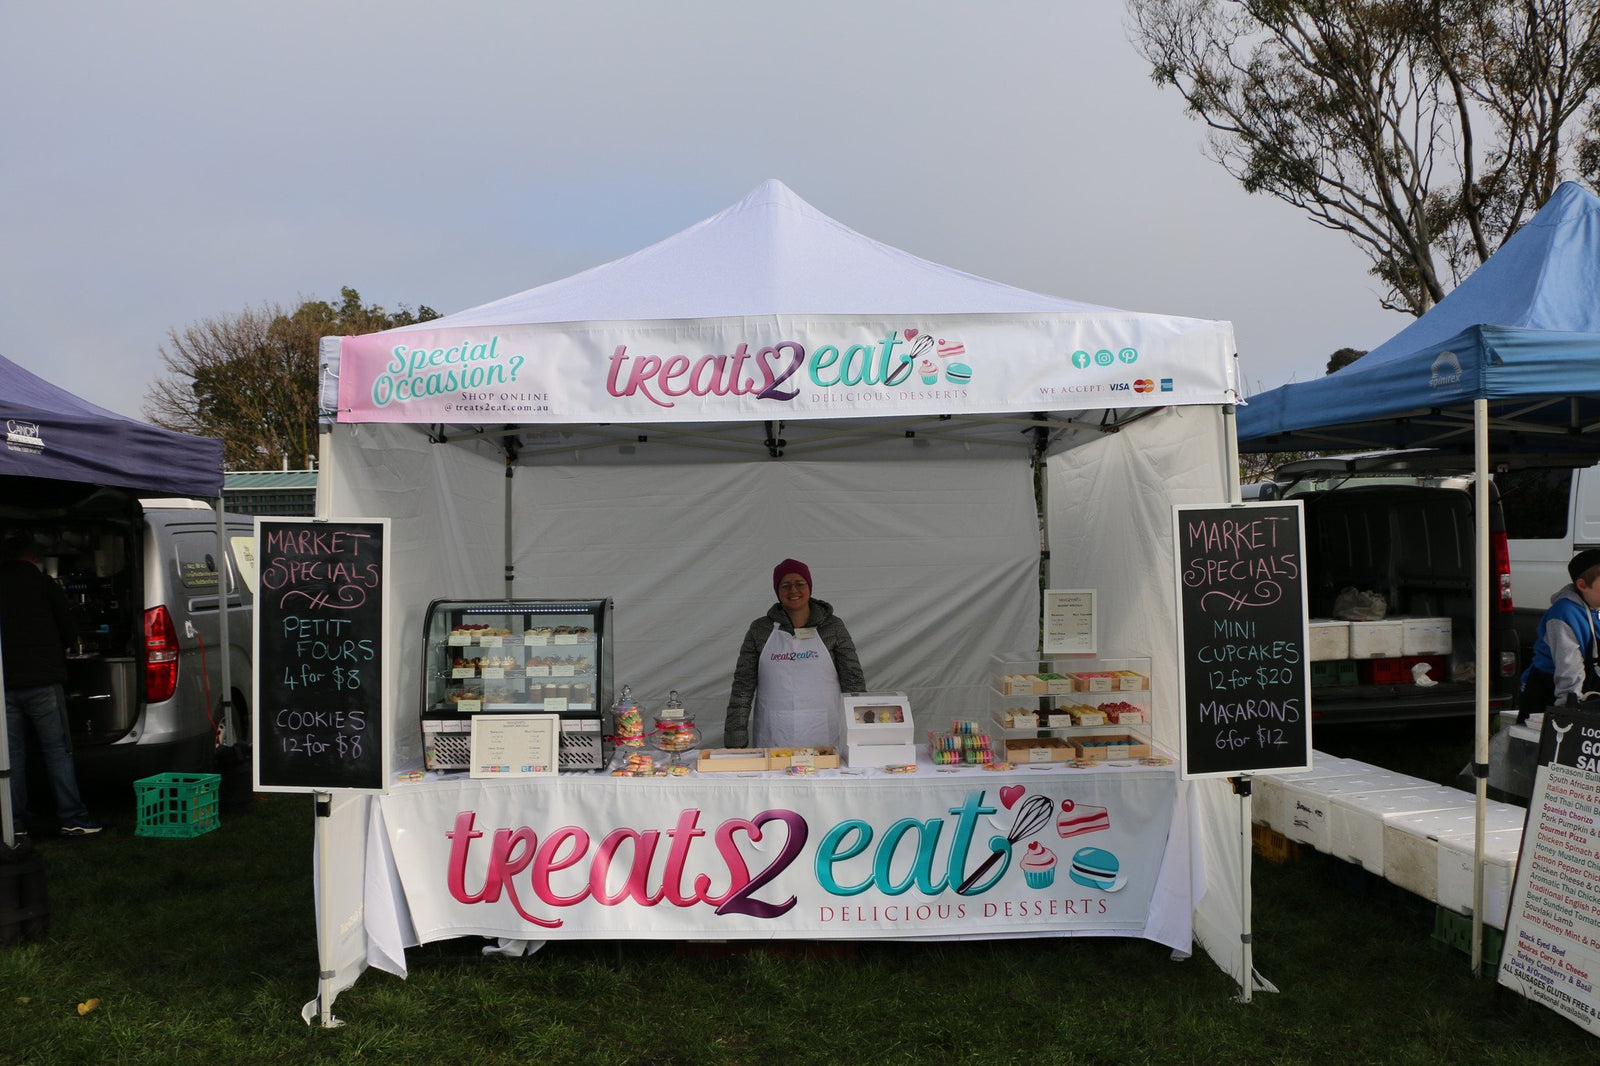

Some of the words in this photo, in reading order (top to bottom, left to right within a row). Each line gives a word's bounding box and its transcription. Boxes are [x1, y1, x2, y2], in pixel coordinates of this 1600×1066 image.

[388, 336, 499, 377] Special
[374, 356, 525, 406] Occasion?
[1109, 382, 1130, 391] VISA
[456, 402, 549, 412] treats2eat.com.au
[462, 392, 494, 401] SHOP
[500, 392, 549, 401] ONLINE
[812, 392, 891, 403] DELICIOUS
[900, 389, 968, 401] DESSERTS
[267, 529, 371, 556] MARKET
[1188, 516, 1290, 560] MARKET
[262, 557, 379, 590] SPECIALS
[1183, 553, 1298, 588] SPECIALS
[282, 615, 352, 638] PETIT
[1213, 618, 1256, 640] MINI
[297, 639, 375, 662] FOURS
[1198, 641, 1300, 665] CUPCAKES
[332, 665, 361, 691] $8
[1256, 665, 1293, 690] $20
[276, 709, 366, 731] COOKIES
[1199, 698, 1300, 726] MACARONS
[335, 731, 363, 759] $8
[1256, 724, 1289, 749] $12
[1546, 783, 1568, 795] Italian
[1569, 789, 1585, 800] Pork
[1549, 773, 1568, 785] South
[1569, 779, 1594, 791] African
[1544, 792, 1558, 803] Red
[1559, 797, 1574, 808] Thai
[1541, 812, 1556, 823] Pork
[1558, 817, 1589, 835] Pumpkin
[1543, 803, 1567, 817] Spanish
[1568, 810, 1594, 825] Chorizo
[1537, 832, 1563, 847] Chicken
[1564, 841, 1593, 857] Spinach
[1539, 822, 1567, 838] Gourmet
[1568, 831, 1587, 844] Pizza
[1533, 852, 1556, 866] Lemon
[1557, 860, 1583, 876] Pepper
[1535, 842, 1556, 857] Honey
[1557, 850, 1586, 866] Mustard
[1530, 871, 1561, 890] Aromatic
[1561, 883, 1576, 896] Thai
[1531, 861, 1558, 877] Chicken
[1559, 871, 1585, 888] Cheese
[1526, 891, 1542, 903] Beef
[1542, 898, 1573, 917] Sundried
[1528, 880, 1564, 902] Traditional
[1564, 895, 1590, 911] English
[820, 901, 967, 923] DELICIOUS
[983, 899, 1108, 918] DESSERTS
[1524, 900, 1553, 919] Souvlaki
[1553, 912, 1574, 927] Lamb
[1522, 910, 1541, 925] Lamb
[1542, 919, 1564, 936] Honey
[1564, 928, 1581, 942] Mint
[1519, 930, 1535, 944] Black
[1536, 938, 1550, 951] Eyed
[1551, 945, 1566, 957] Beef
[1511, 957, 1525, 970] Duck
[1517, 940, 1538, 956] Madras
[1539, 950, 1556, 965] Curry
[1565, 962, 1589, 980] Cheese
[1517, 950, 1535, 965] Turkey
[1536, 960, 1567, 981] Cranberry
[1575, 979, 1592, 993] Basil
[1502, 963, 1514, 974] ALL
[1514, 968, 1546, 990] SAUSAGES
[1546, 985, 1571, 1004] GLUTEN
[1571, 998, 1590, 1014] FREE
[1533, 989, 1560, 1006] seasonal
[1559, 1002, 1592, 1025] availability
